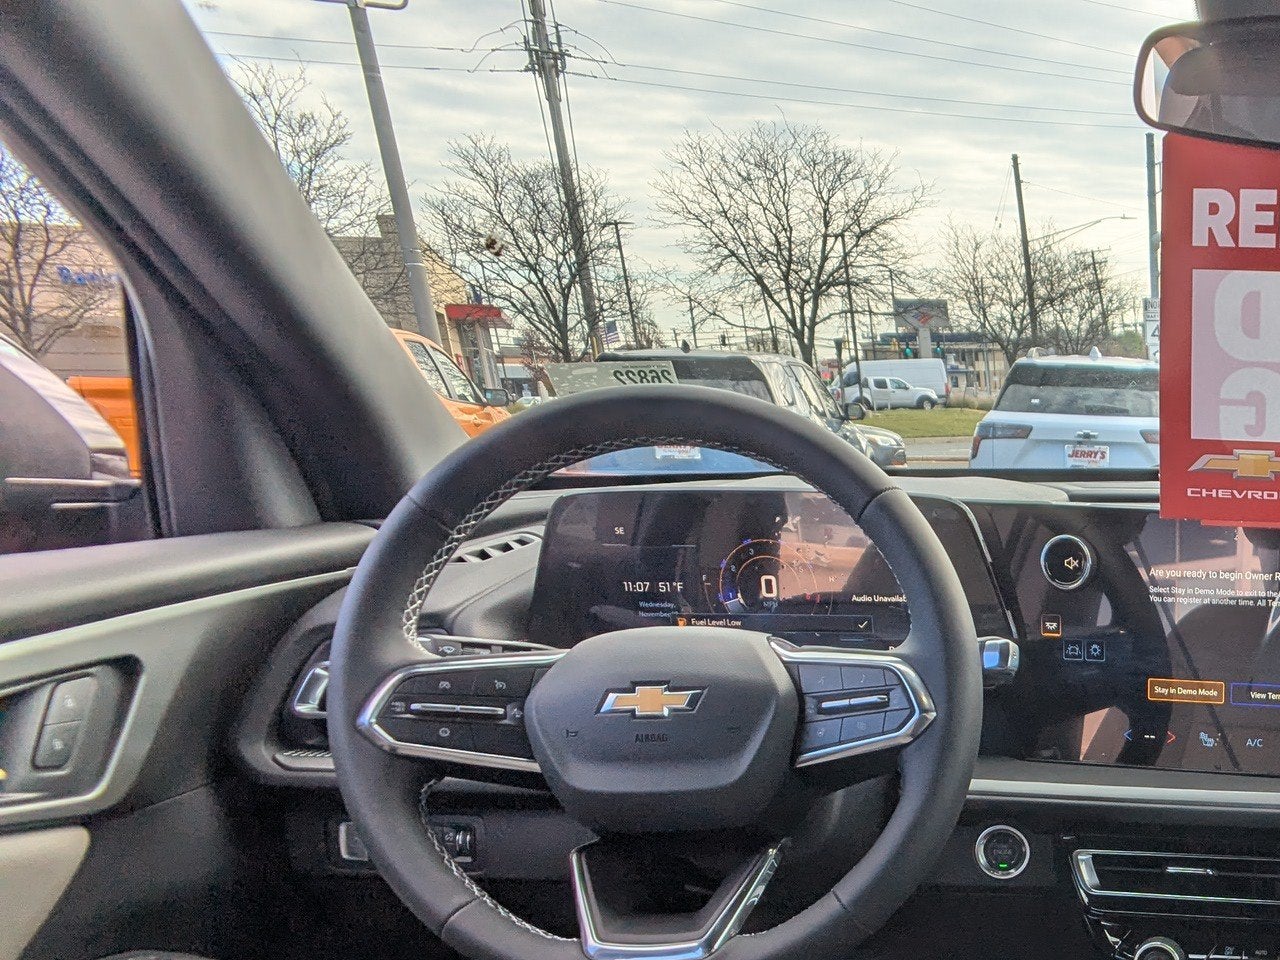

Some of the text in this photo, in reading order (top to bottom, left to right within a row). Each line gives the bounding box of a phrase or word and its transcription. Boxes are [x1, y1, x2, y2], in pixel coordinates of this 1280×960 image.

[1067, 449, 1107, 460] JERRY'S
[1149, 568, 1164, 576] Are
[1166, 570, 1182, 579] you
[1183, 570, 1206, 580] ready
[1209, 571, 1218, 579] to
[1220, 571, 1243, 582] begin
[1244, 572, 1273, 581] Owner
[622, 581, 650, 592] 11:07
[760, 574, 778, 598] 0
[1149, 586, 1170, 594] Select
[1171, 587, 1186, 596] Stay
[1216, 588, 1235, 596] Mode
[1266, 590, 1278, 598] the
[1176, 596, 1202, 605] register
[1212, 598, 1236, 606] another
[1238, 598, 1256, 606] time.
[691, 618, 707, 626] Fuel
[708, 618, 726, 626] Level
[1154, 686, 1168, 696] Stay
[1178, 687, 1197, 696] Demo
[1198, 688, 1218, 696] Mode
[1250, 692, 1267, 700] View
[1246, 738, 1263, 748] A/C
